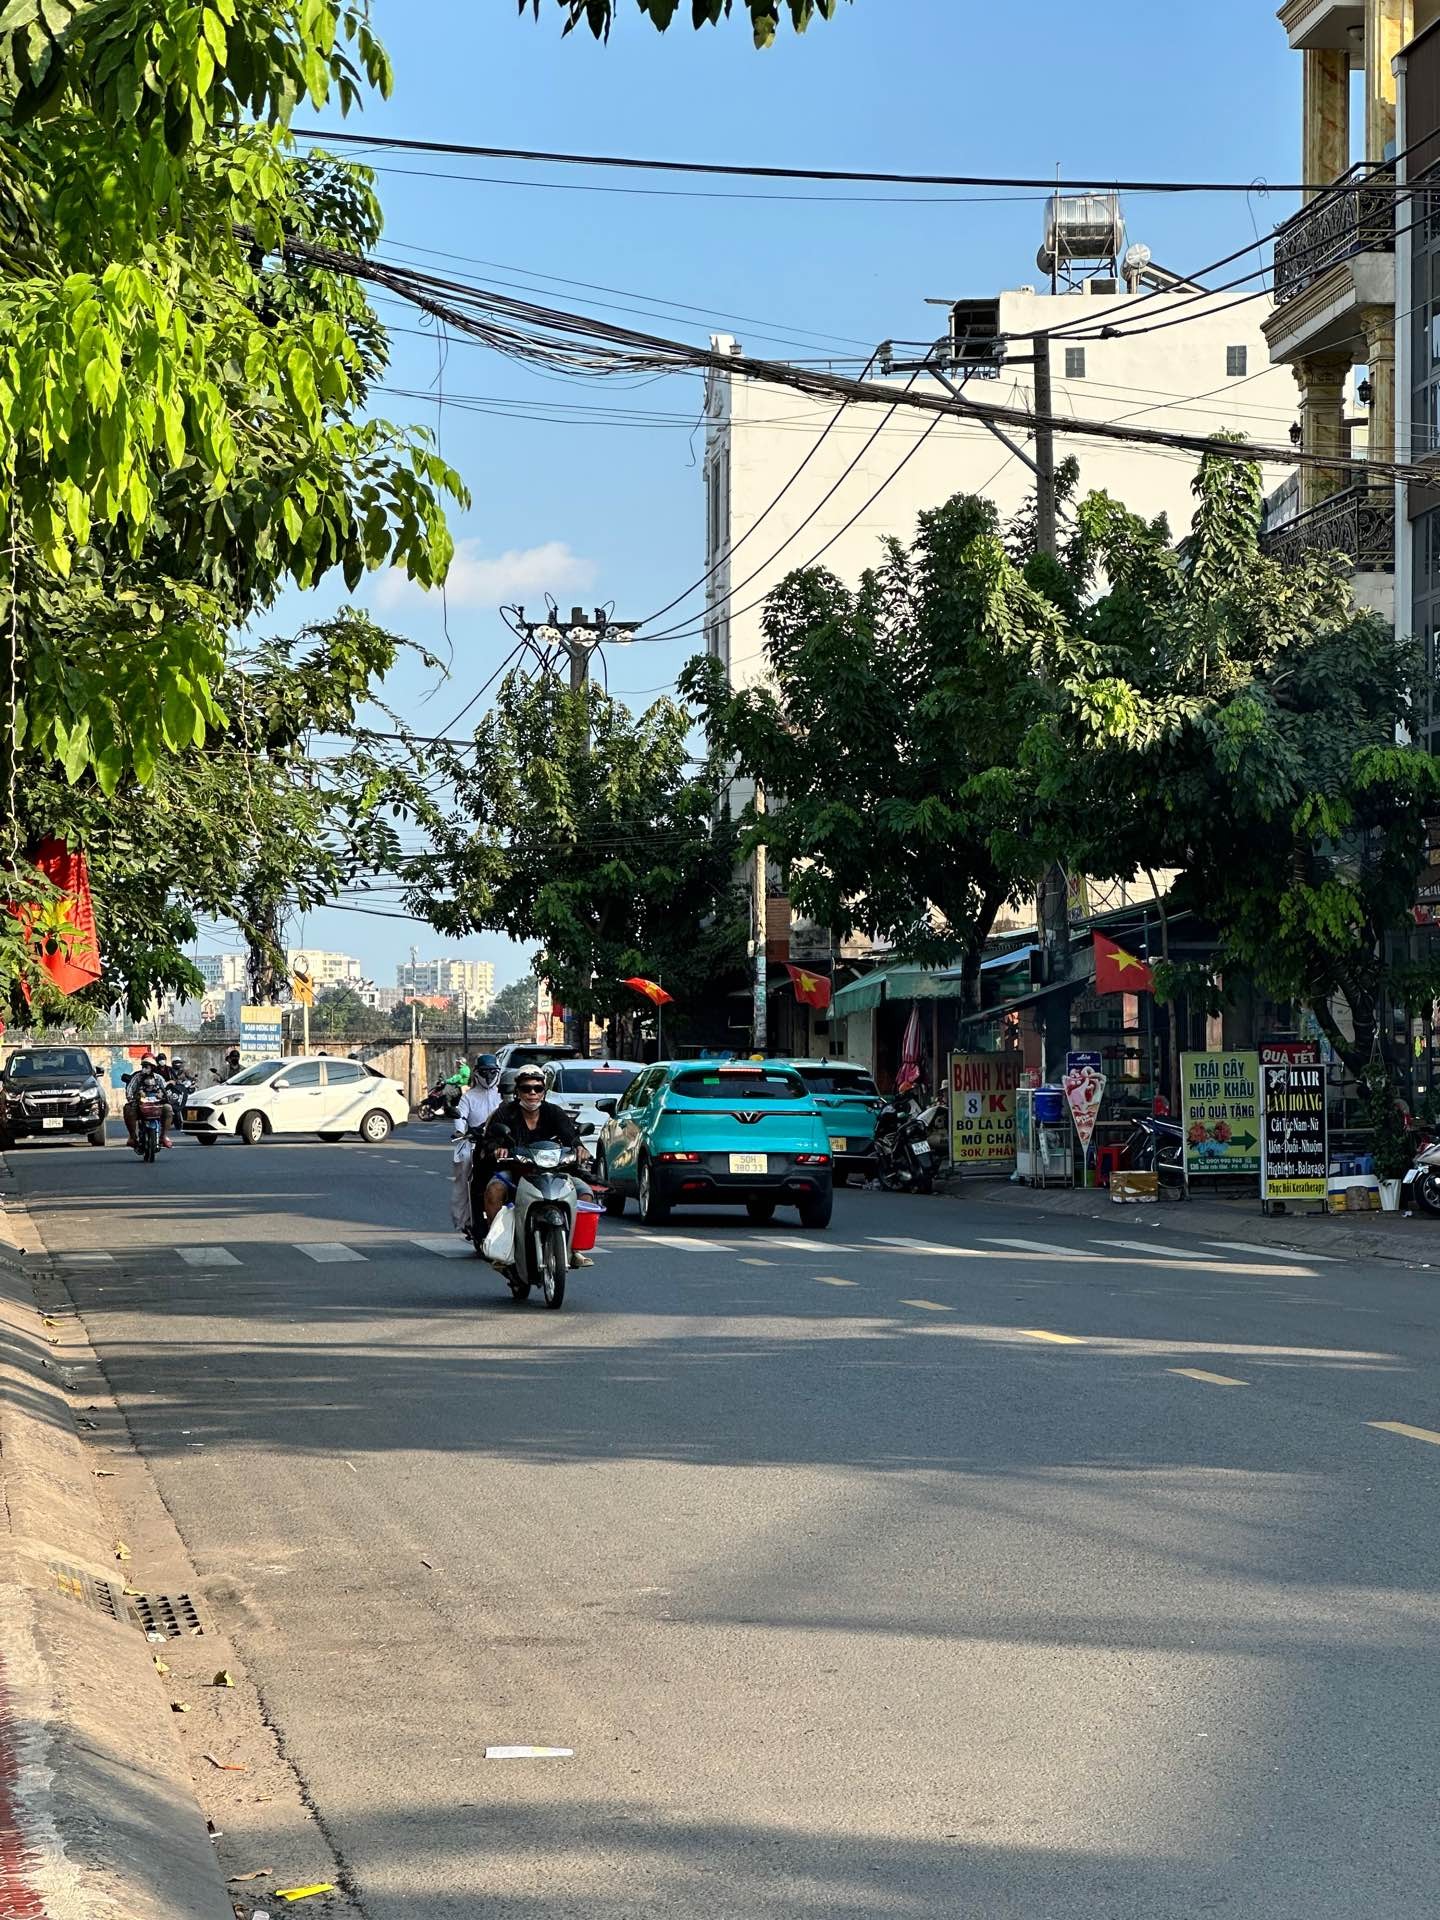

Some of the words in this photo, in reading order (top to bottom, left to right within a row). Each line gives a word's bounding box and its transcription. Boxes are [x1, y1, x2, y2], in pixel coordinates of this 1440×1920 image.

[1263, 1049, 1288, 1064] QUÀ
[1293, 1050, 1315, 1064] TẾT
[954, 1056, 990, 1092] BÁNH
[1194, 1060, 1219, 1077] TRÁI
[1223, 1058, 1244, 1077] CÂY
[1290, 1071, 1320, 1086] HAIR
[1189, 1080, 1220, 1100] NHẬP
[1224, 1078, 1255, 1097] KHẨU
[968, 1098, 978, 1114] 8
[990, 1094, 1008, 1113] K
[1289, 1089, 1322, 1111] HOÀNG
[1190, 1102, 1205, 1118] GIỎ
[1208, 1103, 1228, 1118] QUÀ
[1230, 1103, 1254, 1119] TẶNG
[1293, 1117, 1307, 1131] Nam
[1267, 1161, 1295, 1178] Highlight
[1297, 1161, 1325, 1177] Balayage
